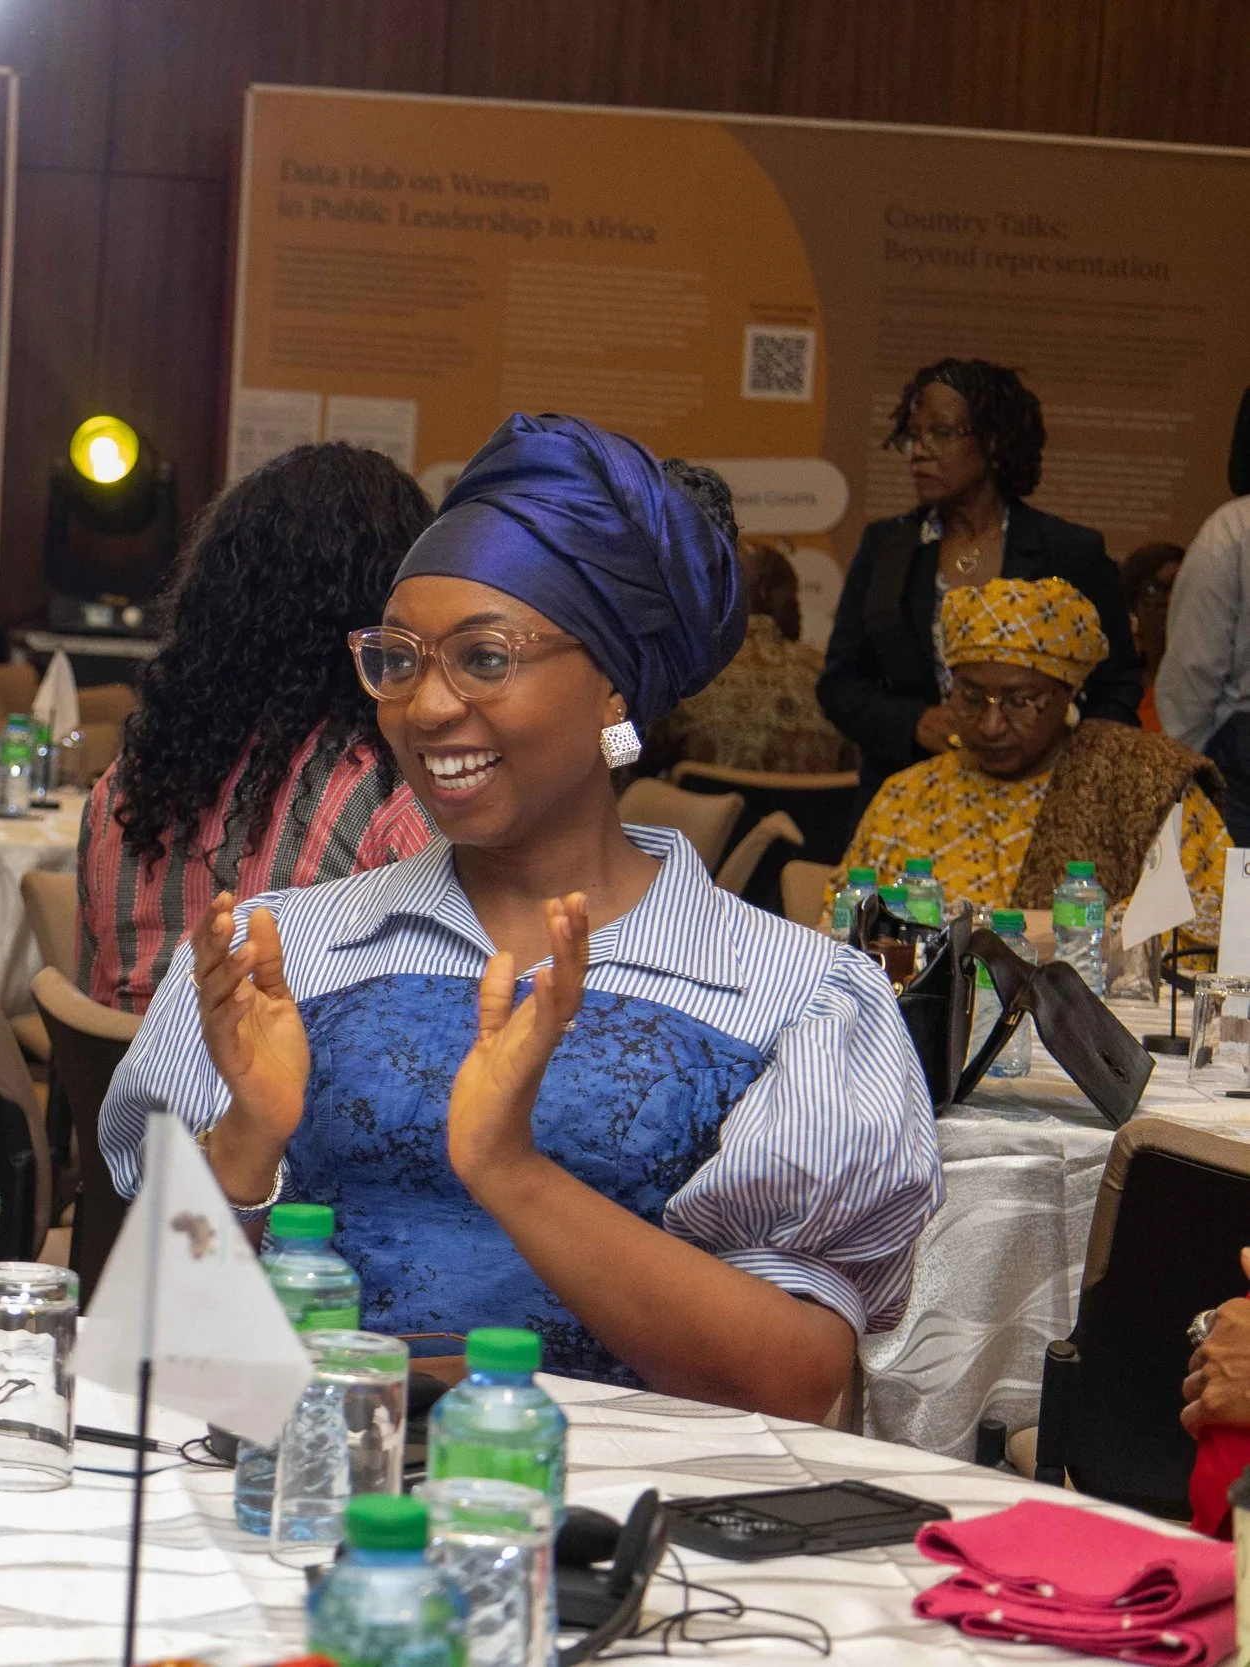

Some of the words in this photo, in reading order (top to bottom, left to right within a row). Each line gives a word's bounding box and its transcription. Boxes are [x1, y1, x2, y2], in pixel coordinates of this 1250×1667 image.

[279, 158, 341, 187] Data
[348, 164, 404, 192] Hub
[408, 173, 443, 195] on
[449, 170, 550, 202] Women
[277, 191, 304, 219] in
[310, 195, 387, 226] Public
[397, 201, 544, 240] Leadership
[549, 212, 573, 237] in
[583, 215, 658, 245] Africa
[883, 204, 988, 240] Country
[883, 238, 978, 270] Beyond
[984, 249, 1170, 282] representation
